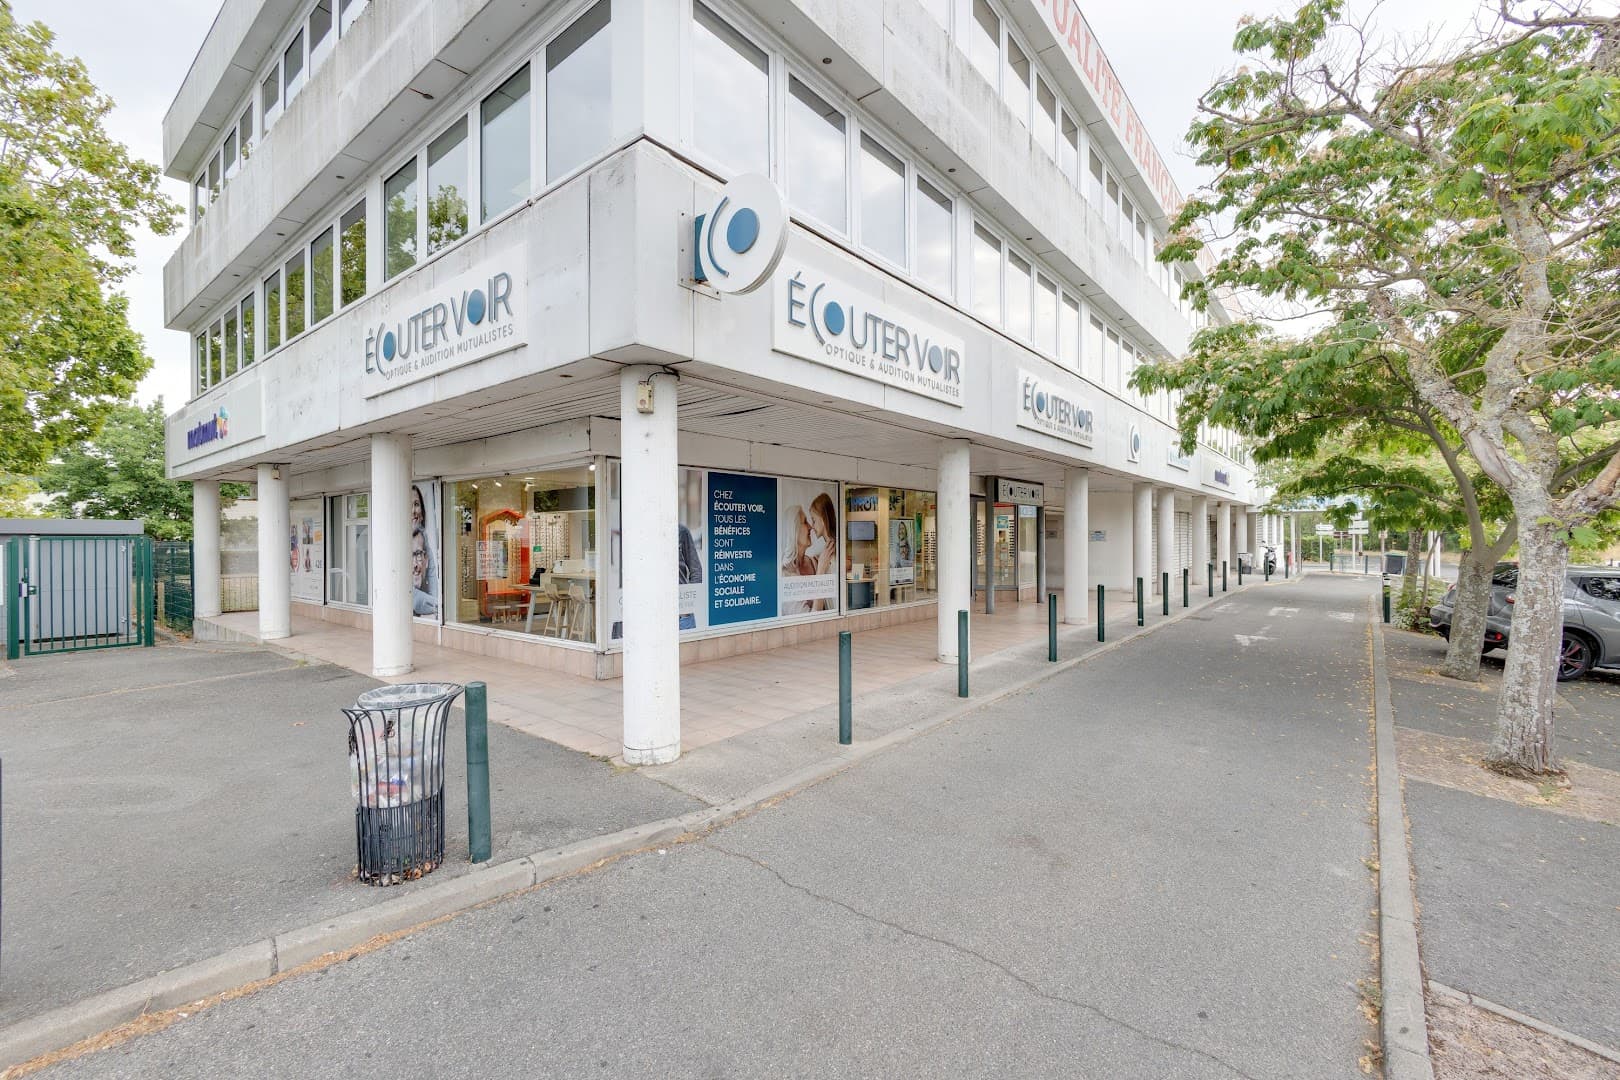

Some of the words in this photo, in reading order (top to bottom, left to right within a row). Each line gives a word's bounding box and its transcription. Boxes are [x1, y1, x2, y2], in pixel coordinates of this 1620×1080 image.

[365, 303, 449, 376] ÉCOUTER
[450, 272, 514, 337] VOIR
[788, 271, 911, 368] ÉCOUTER
[914, 333, 961, 385] VOIR
[385, 362, 412, 381] OPTIQUE
[421, 346, 455, 368] AUDITION
[456, 324, 514, 353] MUTUALISTES
[826, 343, 866, 367] OPTIQUE
[869, 360, 875, 370] &
[878, 362, 915, 382] AUDITION
[918, 375, 960, 398] MUTUALISTES
[1023, 376, 1071, 426] ÉCOUTER
[1072, 404, 1094, 434] VOIR
[714, 490, 733, 500] CHEZ
[714, 502, 746, 512] ÉCOUTER
[747, 504, 766, 514] VOIR,
[714, 514, 734, 524] TOUS
[734, 514, 746, 524] LES
[714, 526, 750, 536] BÉNÉFICES
[714, 539, 734, 548] SONT
[714, 550, 752, 560] RÉINVESTIS
[714, 562, 734, 572] DANS
[714, 573, 756, 584] L'ÉCONOMIE
[714, 586, 744, 596] SOCIALE
[714, 600, 723, 608] ET
[724, 596, 761, 608] SOLIDAIRE.
